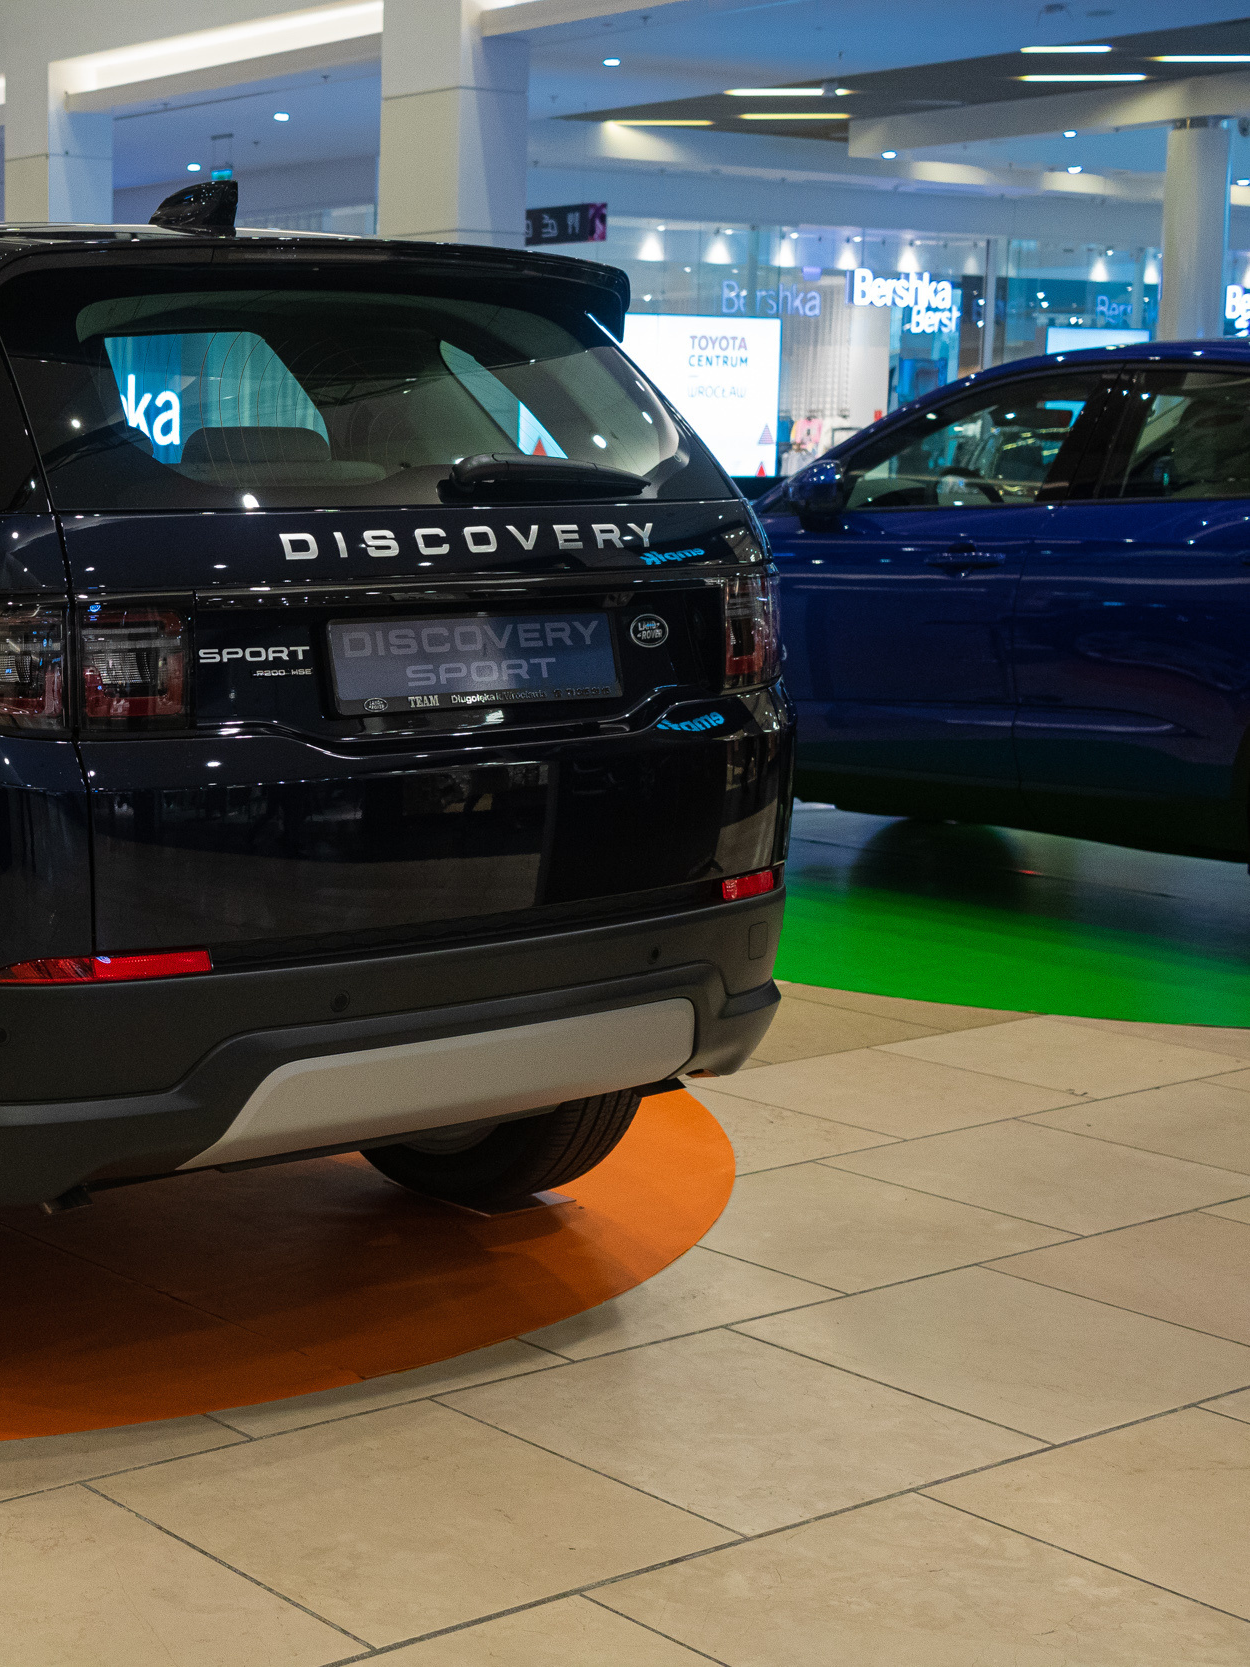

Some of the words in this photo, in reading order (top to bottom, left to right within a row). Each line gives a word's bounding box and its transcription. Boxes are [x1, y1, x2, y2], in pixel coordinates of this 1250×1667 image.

[853, 268, 951, 309] Bershka
[689, 335, 748, 351] TOYOTA
[688, 355, 748, 368] CENTRUM
[279, 522, 654, 561] DISCOVERY
[343, 620, 600, 658] DISCOVERY
[641, 629, 662, 640] ROVER
[198, 646, 310, 663] SPORT
[406, 657, 556, 687] SPORT
[408, 695, 440, 708] TEAM
